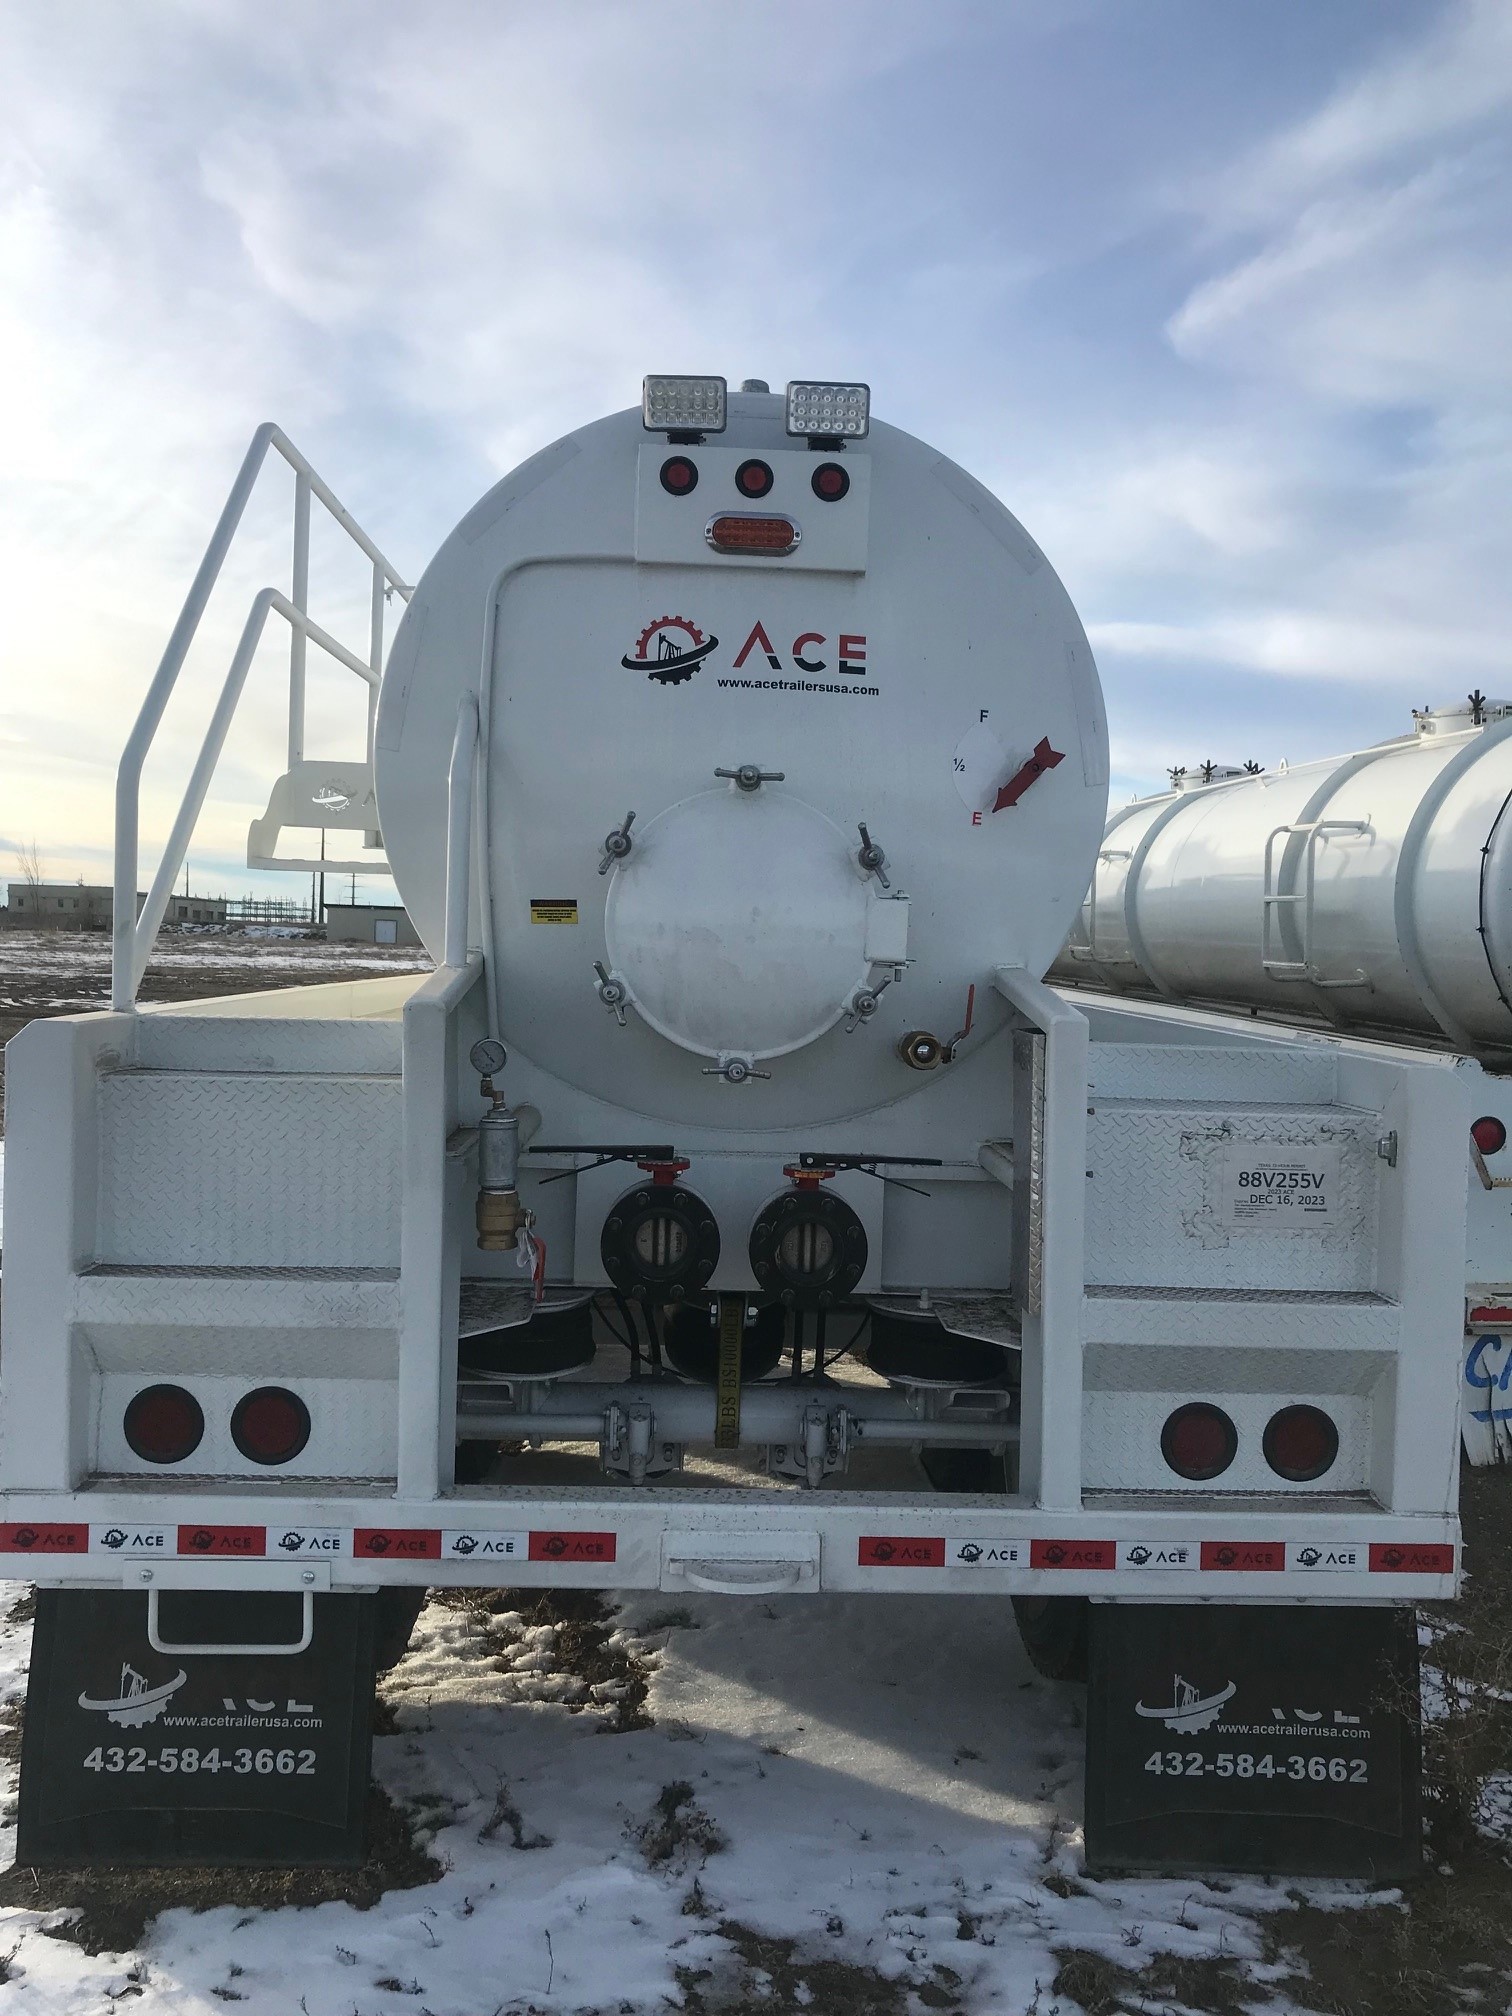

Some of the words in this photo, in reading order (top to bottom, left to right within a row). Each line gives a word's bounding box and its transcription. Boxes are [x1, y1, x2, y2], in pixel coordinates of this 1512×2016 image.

[733, 620, 867, 675] ACE
[717, 678, 880, 696] www.acetrailersusa.com
[980, 709, 989, 722] F
[972, 811, 982, 825] E
[1238, 1171, 1325, 1189] 88V255V
[1250, 1194, 1273, 1204] DEC
[1277, 1195, 1293, 1206] 16,
[1298, 1196, 1325, 1206] 2023
[42, 1534, 76, 1547] ACE
[132, 1534, 164, 1547] ACE
[220, 1536, 251, 1548] ACE
[309, 1538, 341, 1550] ACE
[396, 1540, 427, 1552] ACE
[482, 1541, 514, 1553] ACE
[573, 1542, 604, 1554] ACE
[901, 1548, 932, 1560] ACE
[987, 1549, 1018, 1561] ACE
[1072, 1550, 1104, 1563] ACE
[1156, 1552, 1187, 1563] ACE
[1242, 1553, 1273, 1564] ACE
[1325, 1553, 1356, 1565] ACE
[1409, 1554, 1440, 1565] ACE
[163, 1714, 323, 1729] www.acetrailerusa.com
[1217, 1723, 1371, 1739] www.acetrailerusa.com
[83, 1746, 316, 1775] 432-584-3662
[1144, 1751, 1368, 1784] 432-584-3662
